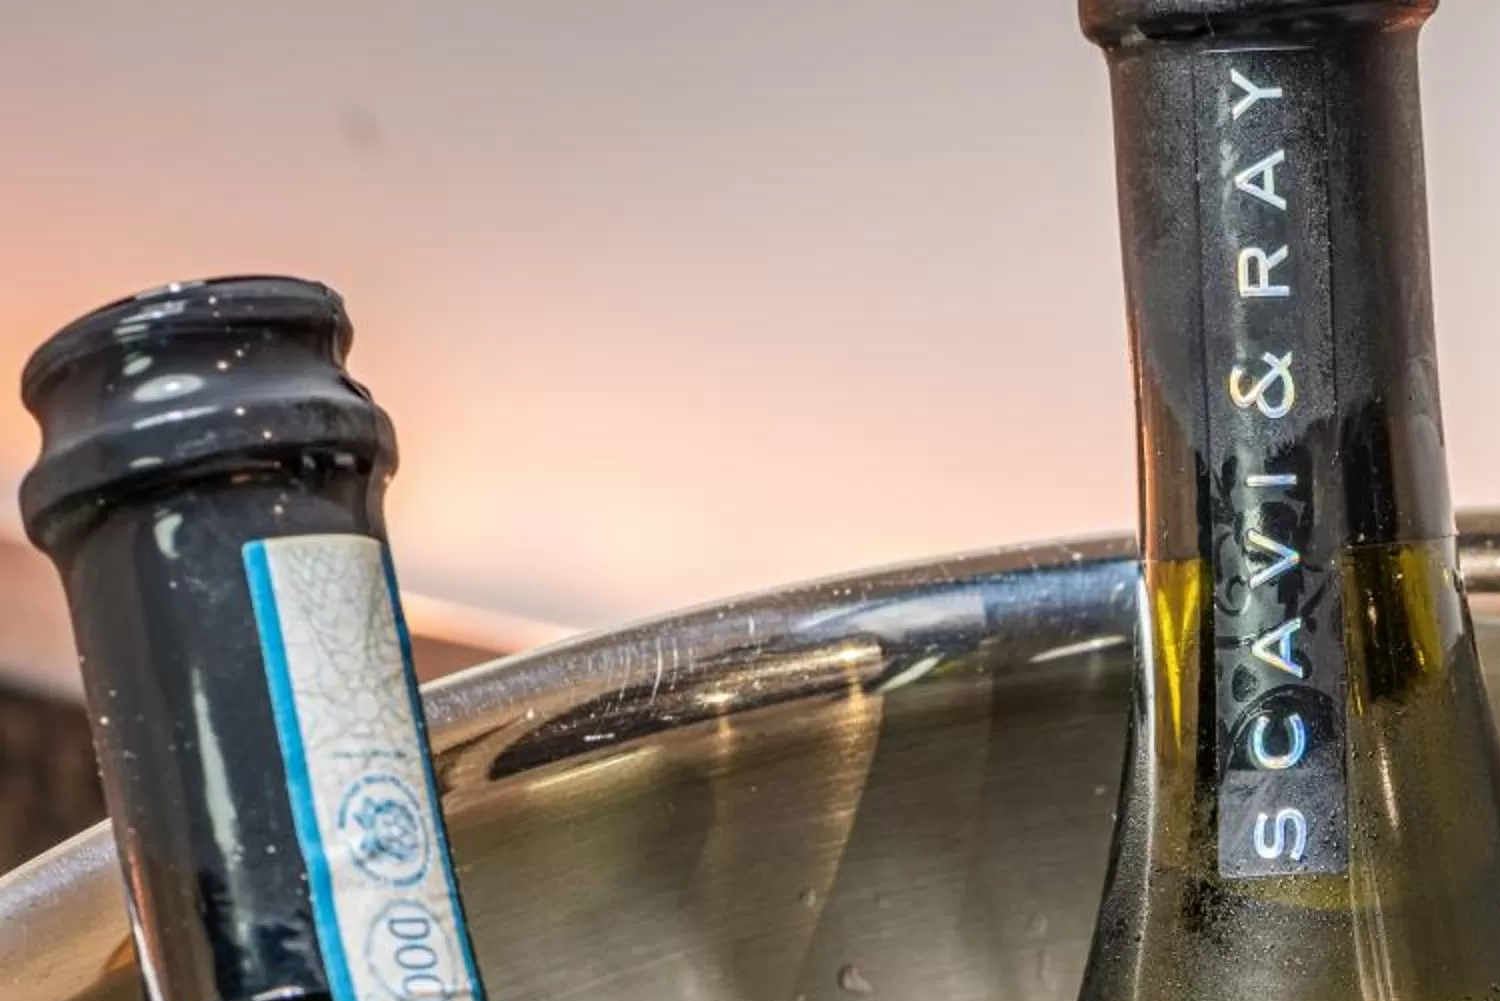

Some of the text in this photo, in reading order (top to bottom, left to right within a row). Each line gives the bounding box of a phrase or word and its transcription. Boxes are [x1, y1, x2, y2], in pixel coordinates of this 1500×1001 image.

[1229, 67, 1307, 862] SCAVI & RAY
